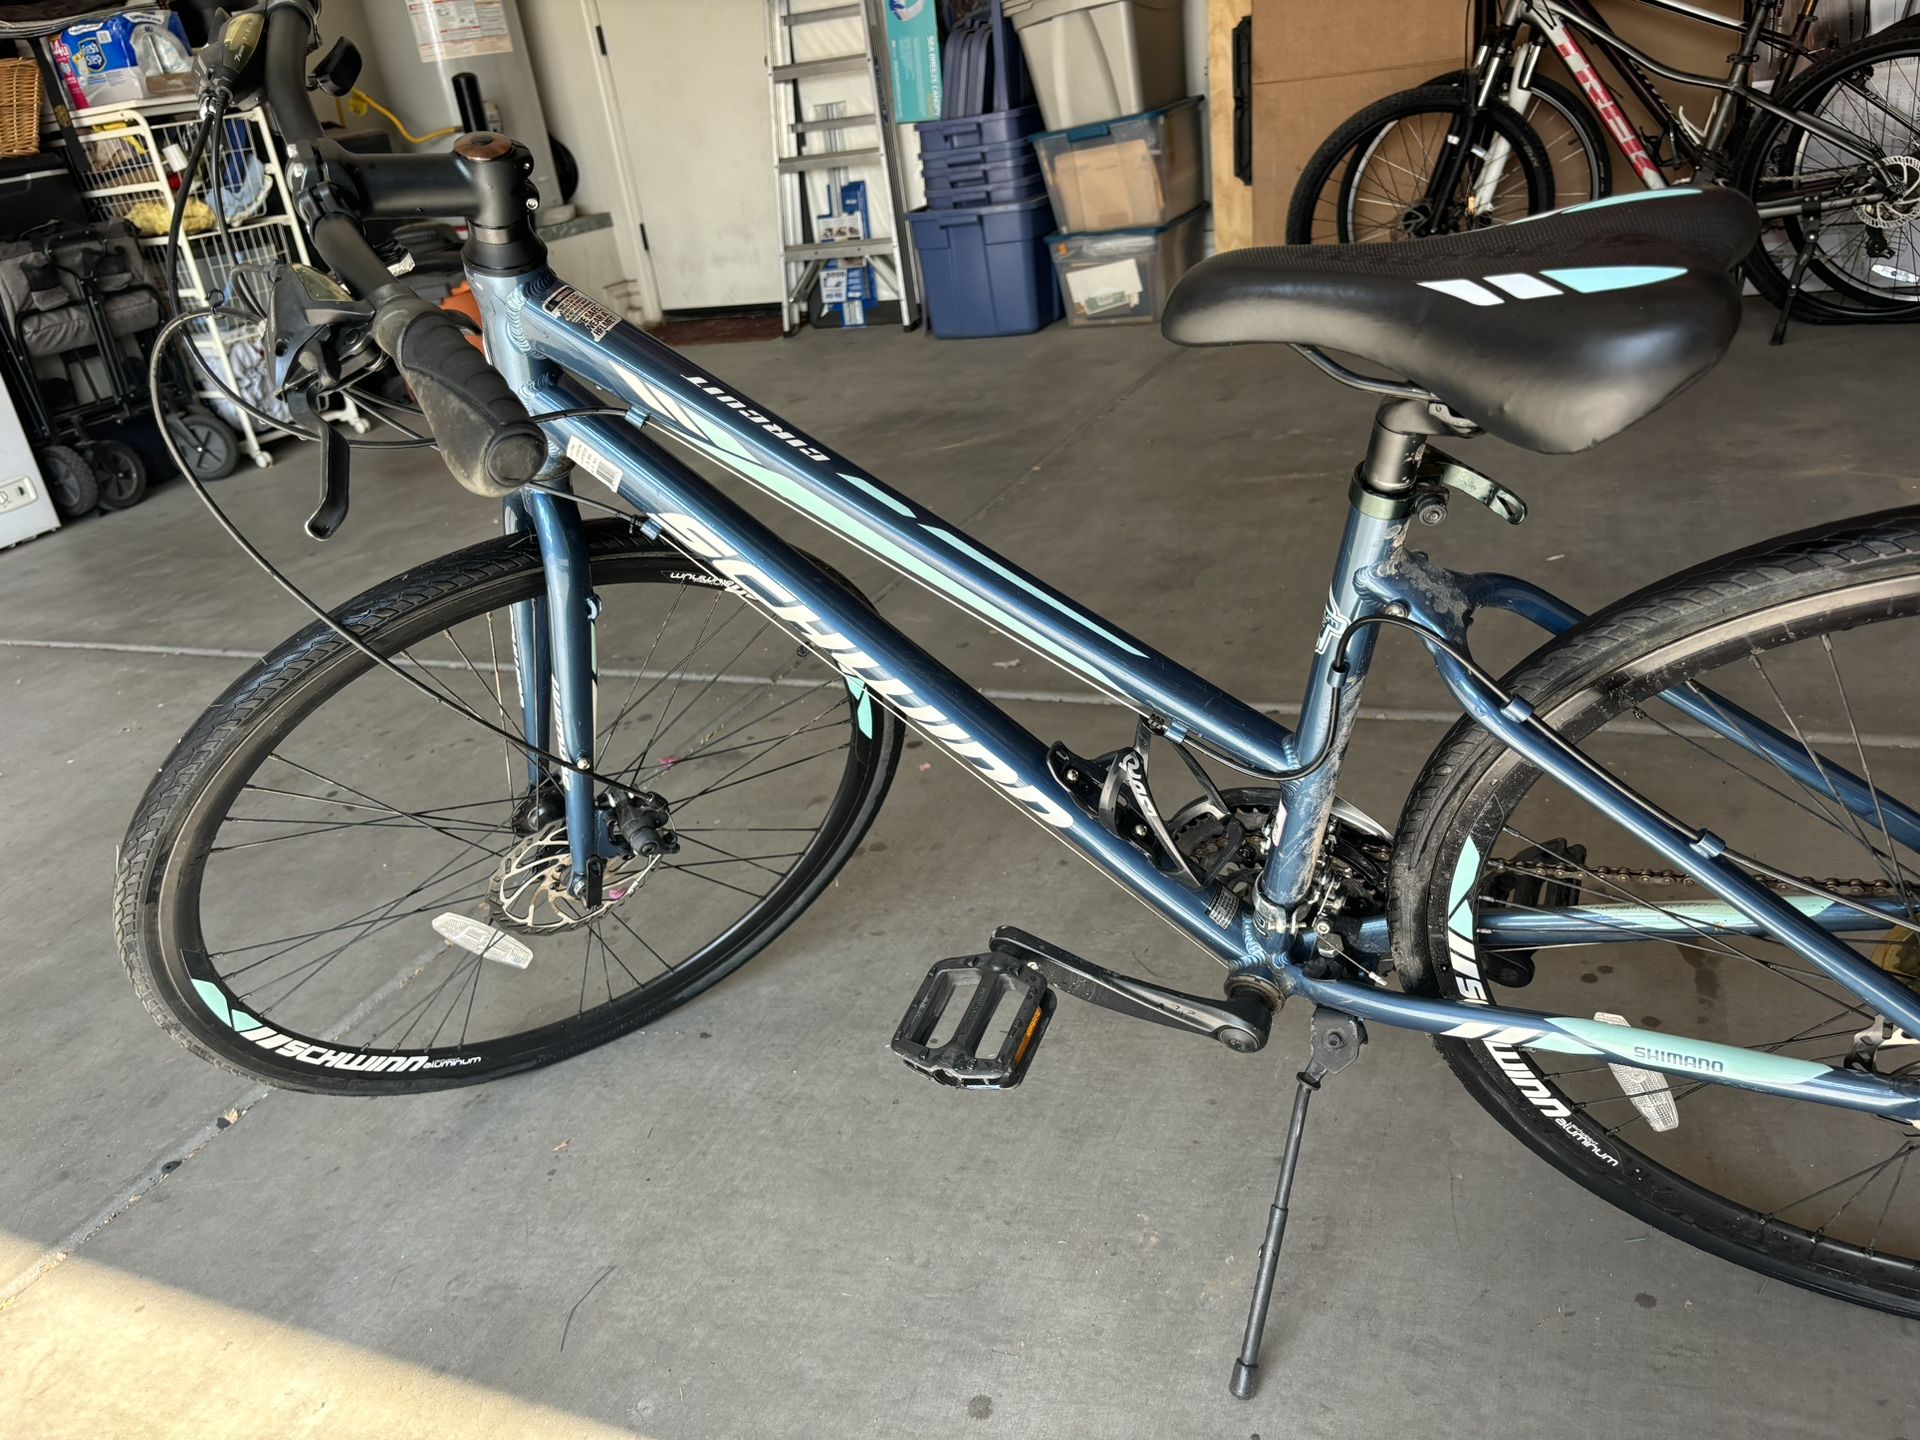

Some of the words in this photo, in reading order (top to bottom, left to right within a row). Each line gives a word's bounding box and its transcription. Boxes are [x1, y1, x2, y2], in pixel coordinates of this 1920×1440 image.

[927, 36, 936, 52] SEA
[1556, 27, 1661, 181] TREK
[680, 374, 831, 462] CIRCUIT
[647, 512, 1075, 829] SCHWINN
[275, 1039, 430, 1072] SCHWINN
[423, 1056, 482, 1070] aluminum
[1634, 1046, 1724, 1073] SHIMANO
[1555, 1117, 1619, 1167] aluminum
